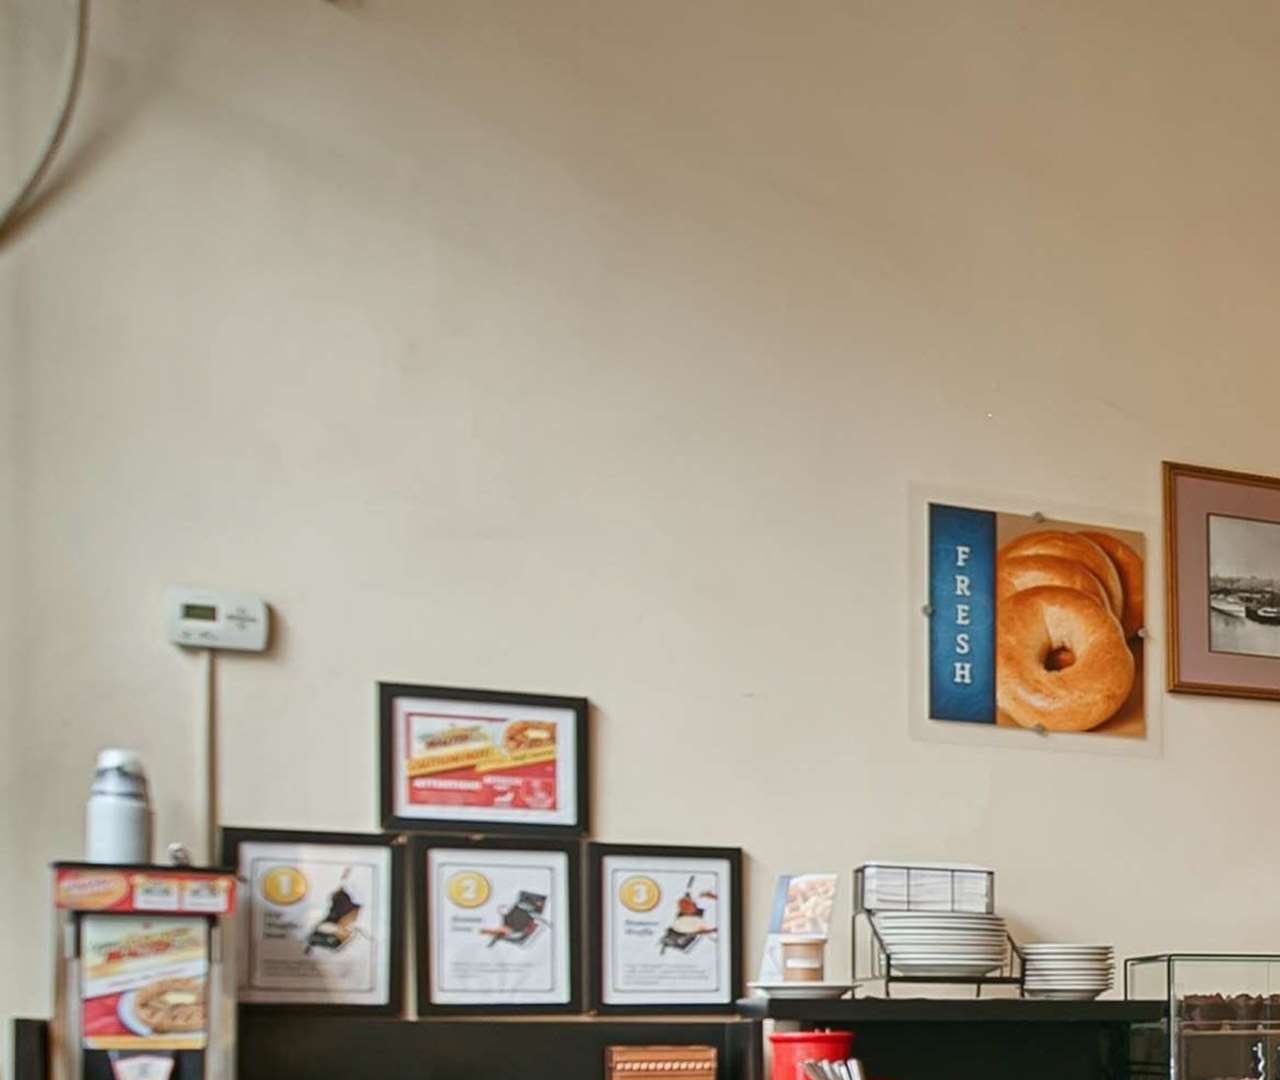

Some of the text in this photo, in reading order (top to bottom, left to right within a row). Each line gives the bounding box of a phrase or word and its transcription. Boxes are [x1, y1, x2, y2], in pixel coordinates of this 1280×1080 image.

[953, 546, 972, 684] FRESH
[463, 879, 477, 899] 2
[633, 884, 647, 904] 3
